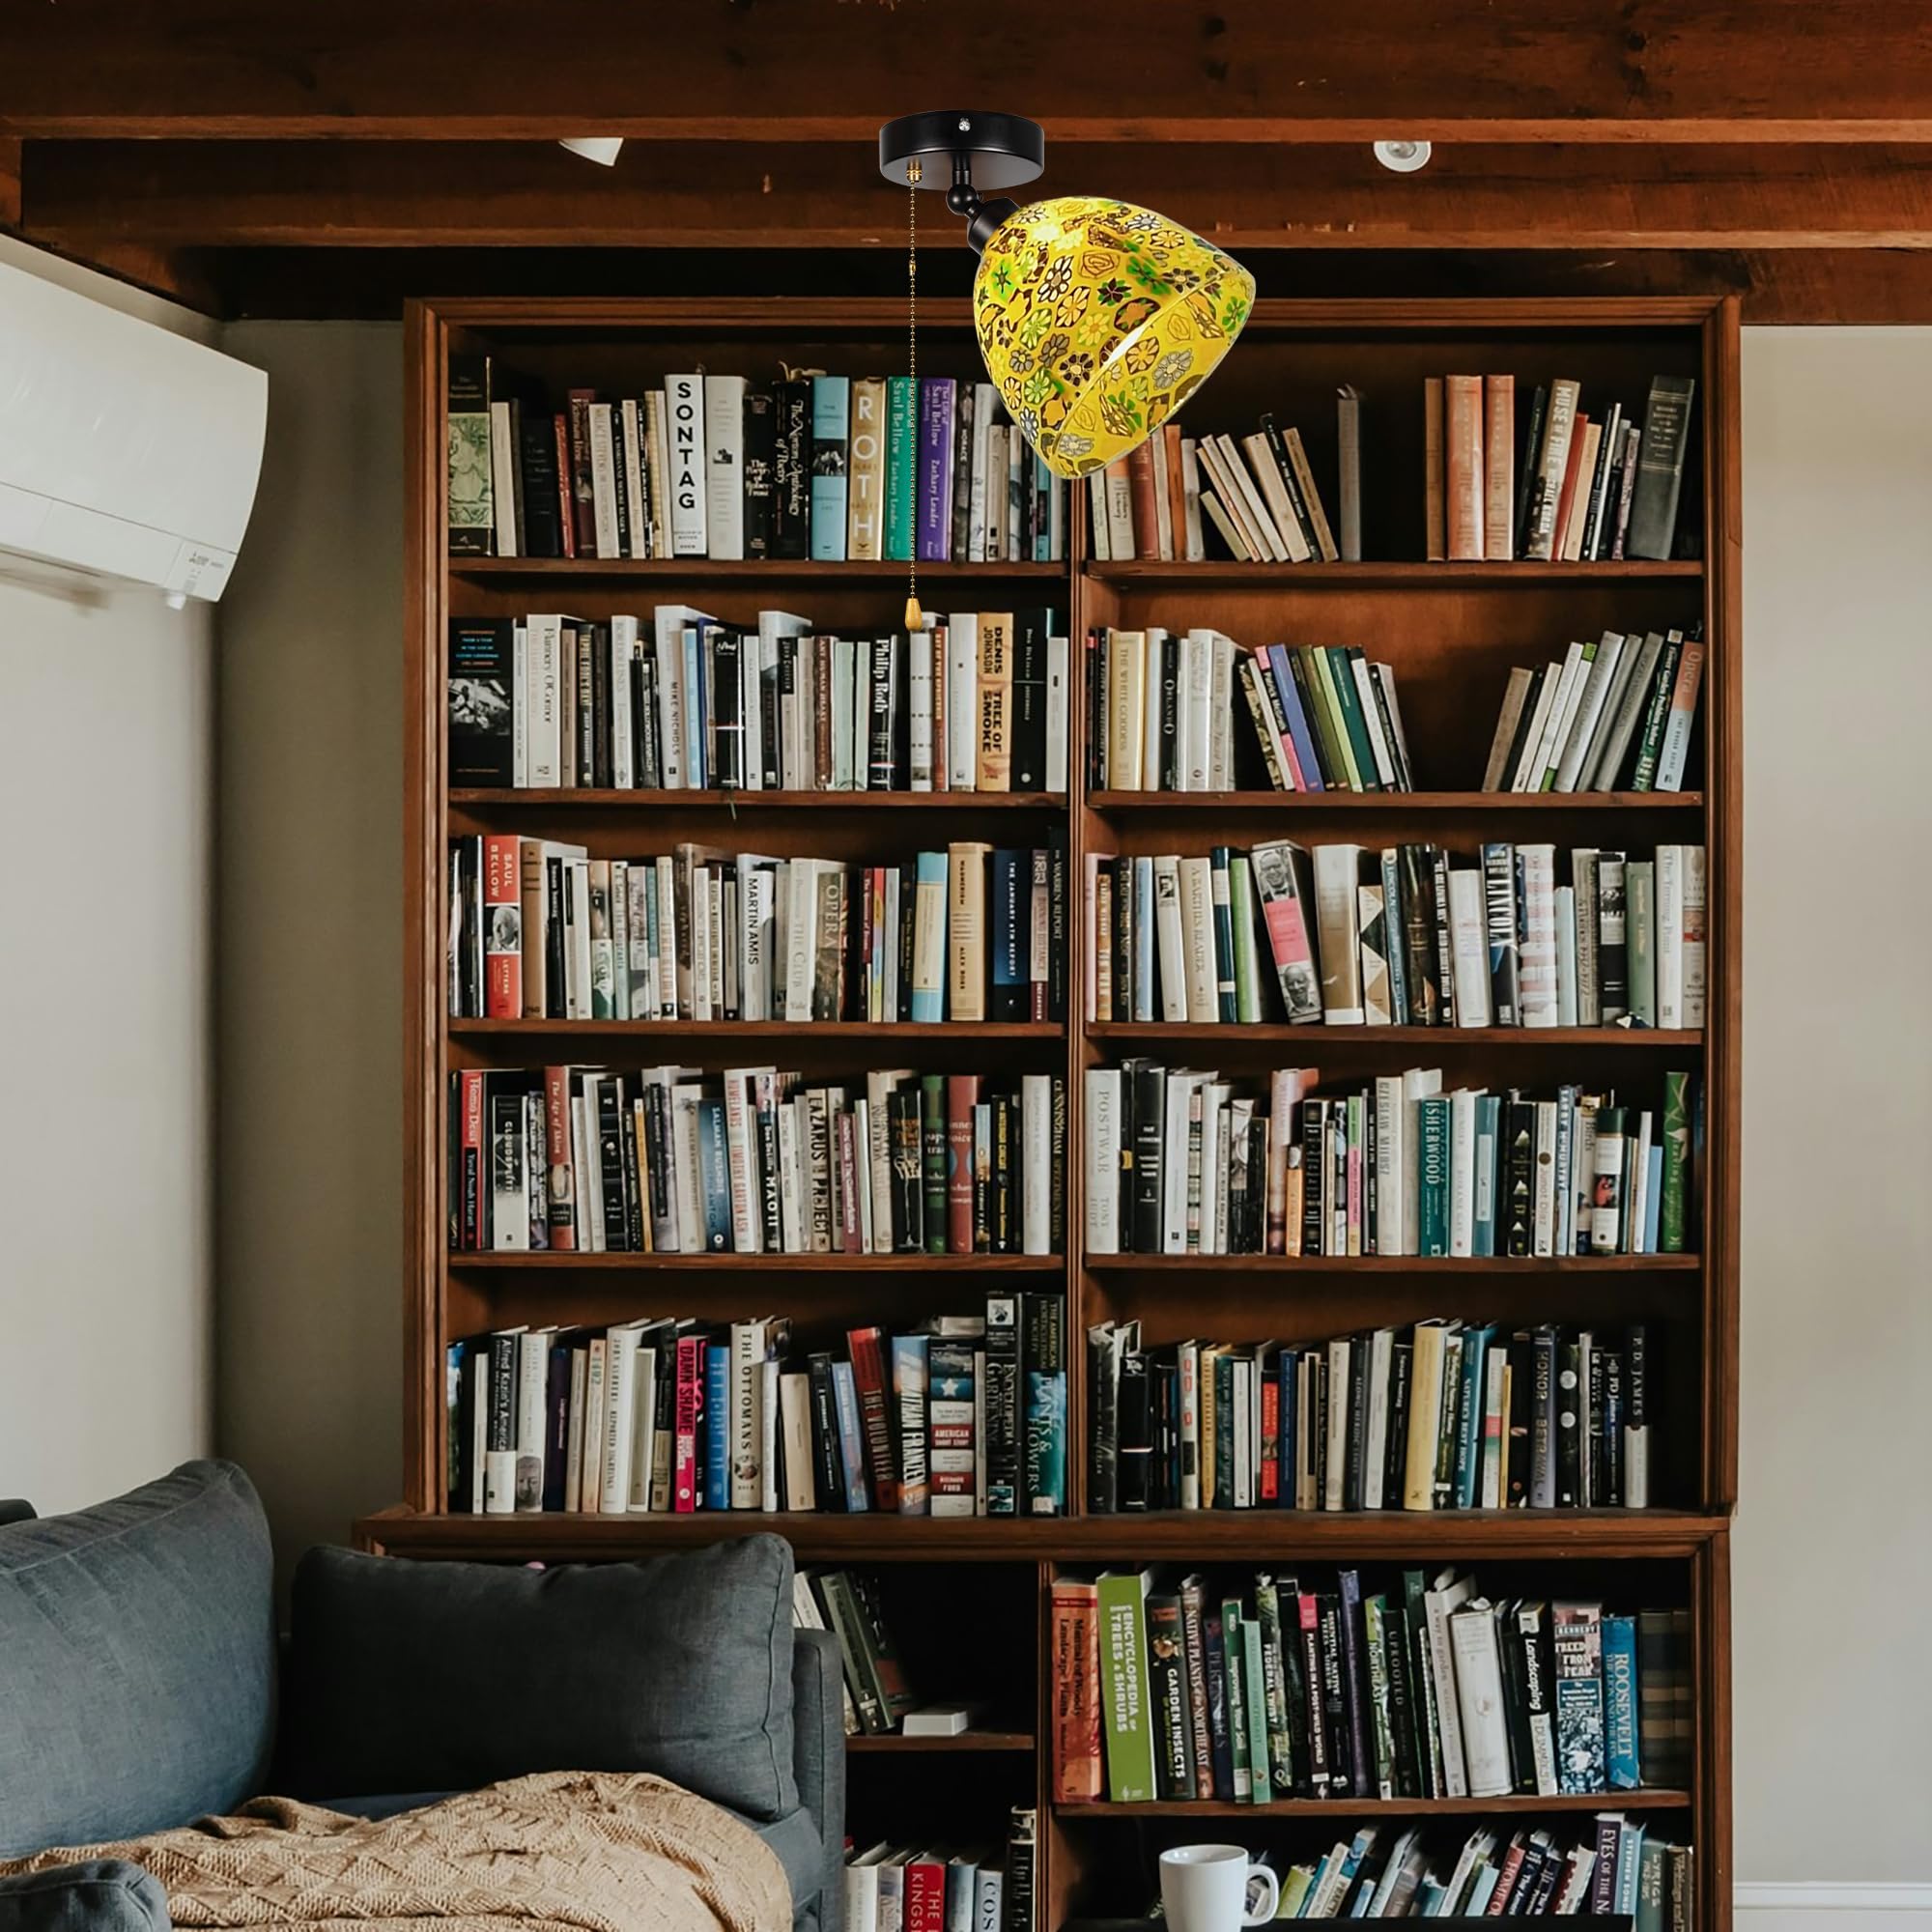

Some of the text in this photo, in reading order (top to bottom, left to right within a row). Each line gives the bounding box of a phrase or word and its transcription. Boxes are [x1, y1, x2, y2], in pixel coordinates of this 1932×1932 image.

[677, 383, 696, 508] SONTAG
[1548, 386, 1571, 464] MUSE FIRE
[873, 639, 890, 713] Philip Roth
[983, 627, 993, 673] JOHNSON
[994, 627, 1003, 673] DENIS
[1682, 650, 1700, 694] Opera
[670, 682, 680, 754] MIKE NICHOLS
[982, 691, 992, 753] SMOKE
[993, 691, 1002, 753] TREE OF
[749, 878, 758, 964] MARTIN AMIS
[825, 885, 838, 948] OPERA
[1487, 880, 1514, 947] LINCOLN
[711, 1107, 722, 1149] SALMAN
[808, 1097, 827, 1160] LAZARUS
[1097, 1091, 1109, 1173] POSTWAR
[1425, 1102, 1439, 1184] ISHERWOOD
[766, 1177, 776, 1210] MAO
[499, 1340, 512, 1450] Alfred Kazin's America
[679, 1346, 694, 1433] DAMN SHAME
[742, 1333, 752, 1449] THE OTTOMANS
[864, 1390, 882, 1409] THE
[1536, 1351, 1548, 1400] HONOR
[1632, 1371, 1641, 1416] JAMES
[902, 1433, 925, 1489] FRANZEN
[935, 1430, 970, 1438] AMERICAN
[1059, 1618, 1069, 1717] Landscape Plants
[1074, 1619, 1084, 1660] Manual
[1110, 1613, 1122, 1660] TREES
[1123, 1612, 1139, 1716] ENCYCLOPEDIA
[1306, 1634, 1316, 1670] PLANTING
[1388, 1631, 1404, 1705] UPROOTED
[1073, 1678, 1084, 1716] Woody
[1114, 1672, 1127, 1731] SHRUBS
[1185, 1609, 1208, 1767] NATIVE PLANTS NORTHEAST
[1231, 1657, 1244, 1749] Improving Your Soil
[1263, 1644, 1277, 1723] FEDERAL TWIST
[1368, 1642, 1380, 1704] NORTHEAST
[1524, 1638, 1543, 1710] Landscaping
[1167, 1668, 1184, 1777] GARDEN INSECTS
[1614, 1653, 1632, 1759] ROOSEVELT
[1601, 1830, 1615, 1858] EYES
[1624, 1839, 1634, 1881] STEPHEN
[1652, 1854, 1661, 1907] LYRICS
